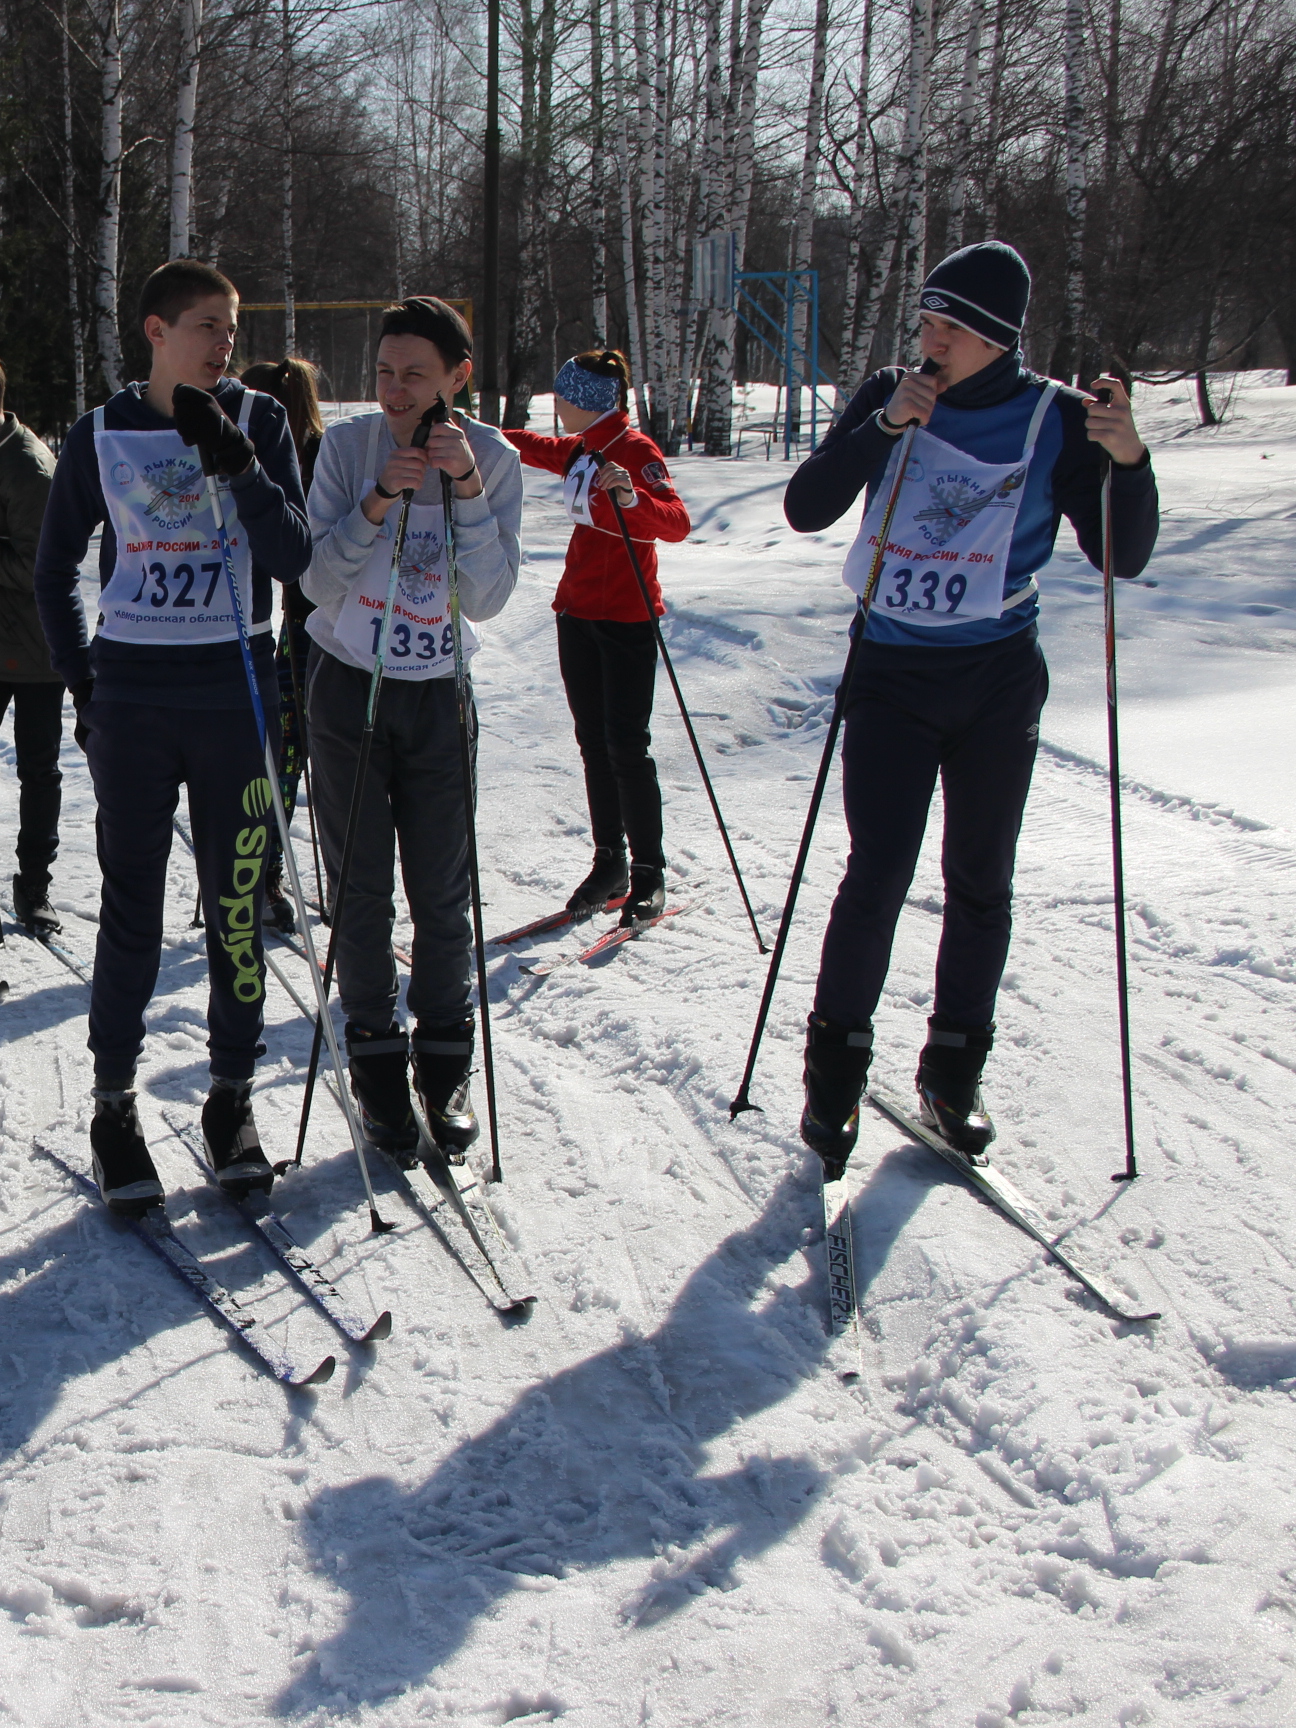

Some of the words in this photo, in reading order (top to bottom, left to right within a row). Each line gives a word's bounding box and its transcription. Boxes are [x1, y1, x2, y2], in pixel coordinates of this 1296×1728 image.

[143, 457, 197, 474] ЛЫЖНЯ
[571, 469, 585, 515] 2
[936, 474, 986, 496] ЛЫЖНЯ
[178, 493, 201, 503] 2014
[151, 512, 193, 531] РОССИИ
[156, 540, 200, 552] РОССИИ
[966, 552, 994, 564] 2014
[131, 561, 223, 608] 1327
[424, 572, 442, 583] 2014
[402, 609, 443, 626] РОССИИ
[219, 824, 268, 1003] adidas
[827, 1233, 852, 1312] FISCHER
